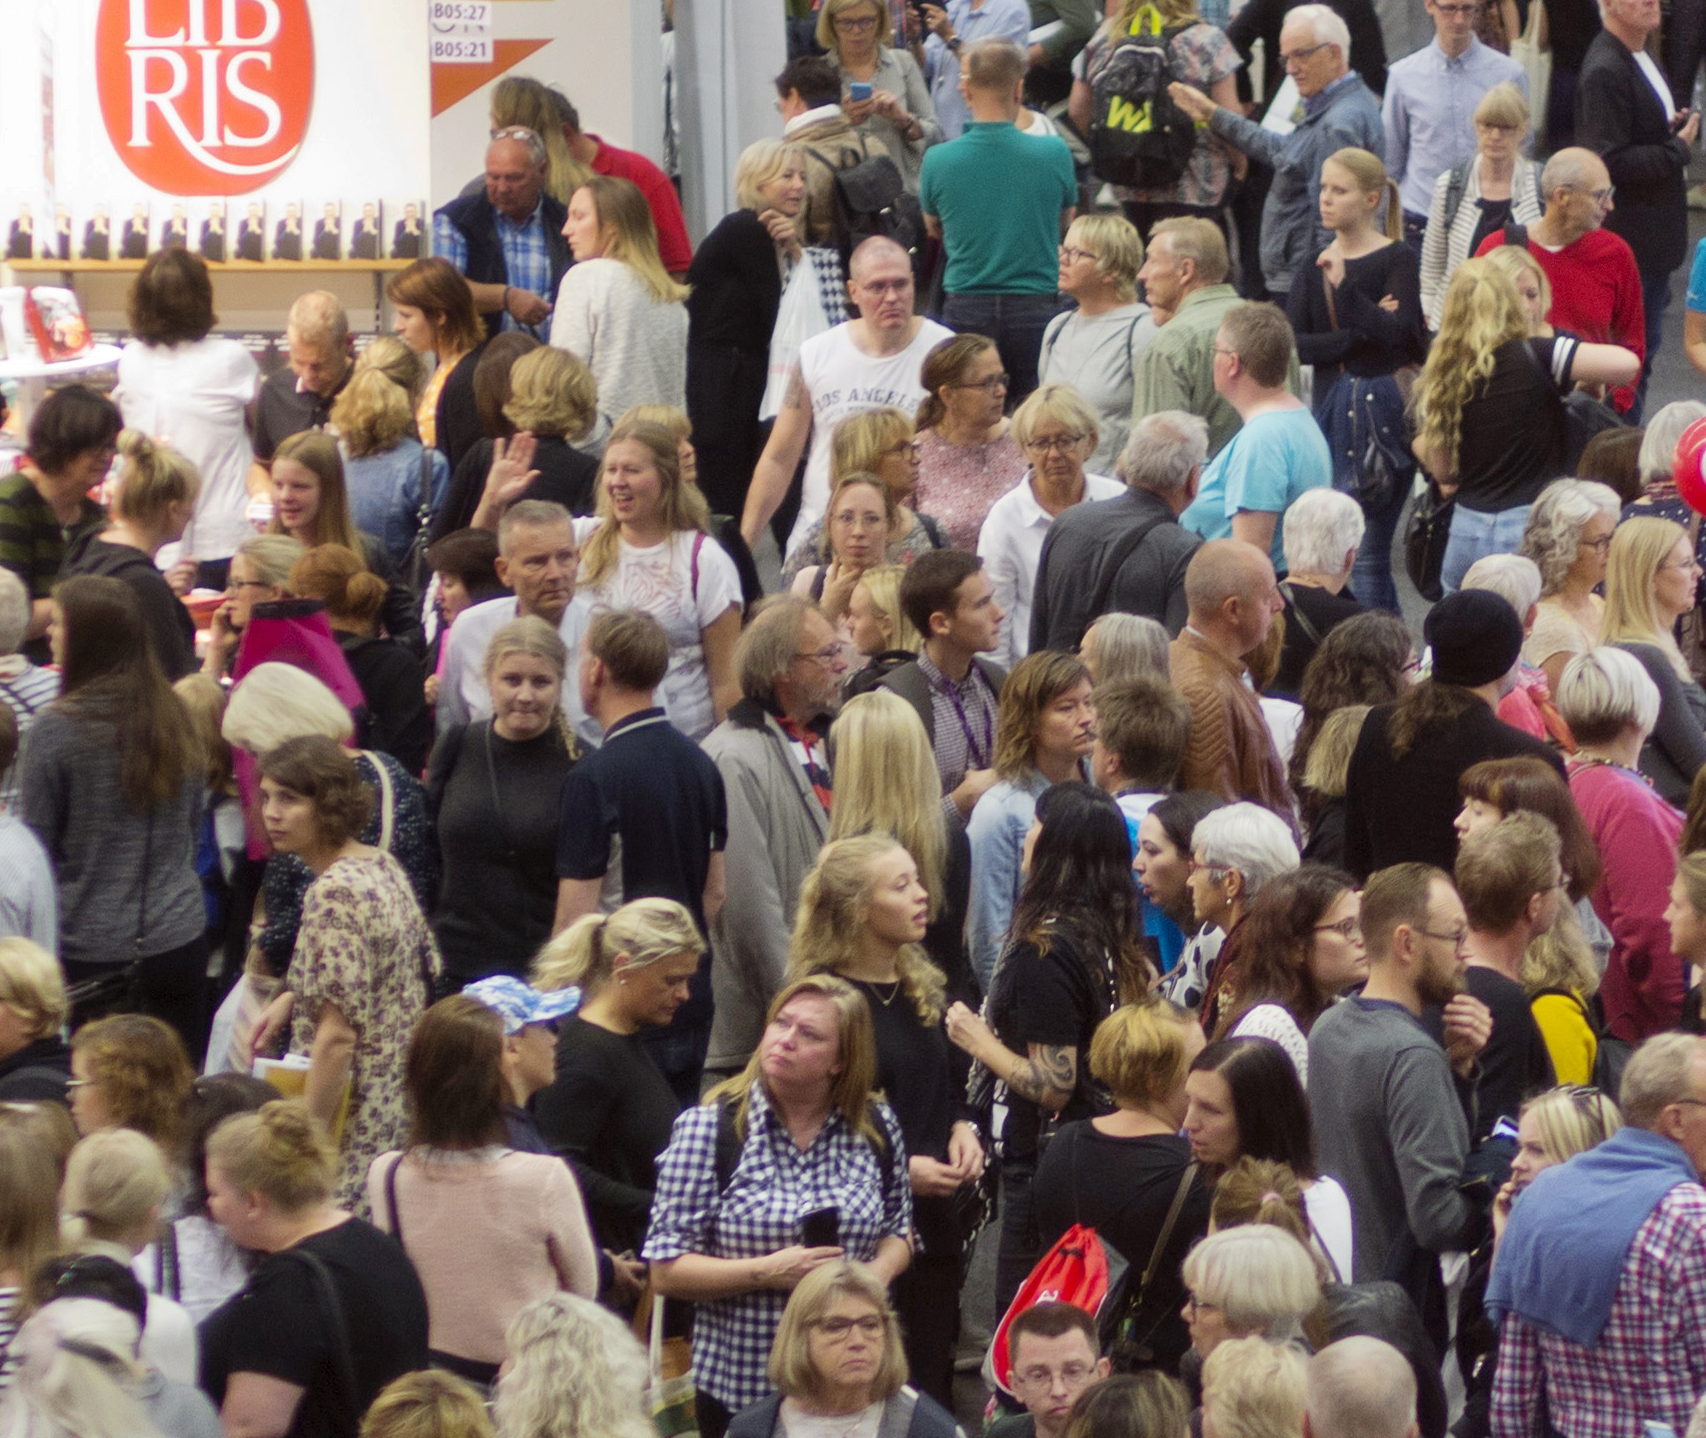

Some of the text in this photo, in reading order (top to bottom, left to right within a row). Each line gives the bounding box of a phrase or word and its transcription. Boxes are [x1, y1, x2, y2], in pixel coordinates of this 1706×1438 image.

[434, 3, 486, 20] B05:27
[434, 41, 486, 57] B05:21
[125, 48, 299, 175] RIS
[847, 387, 918, 414] ANGELE
